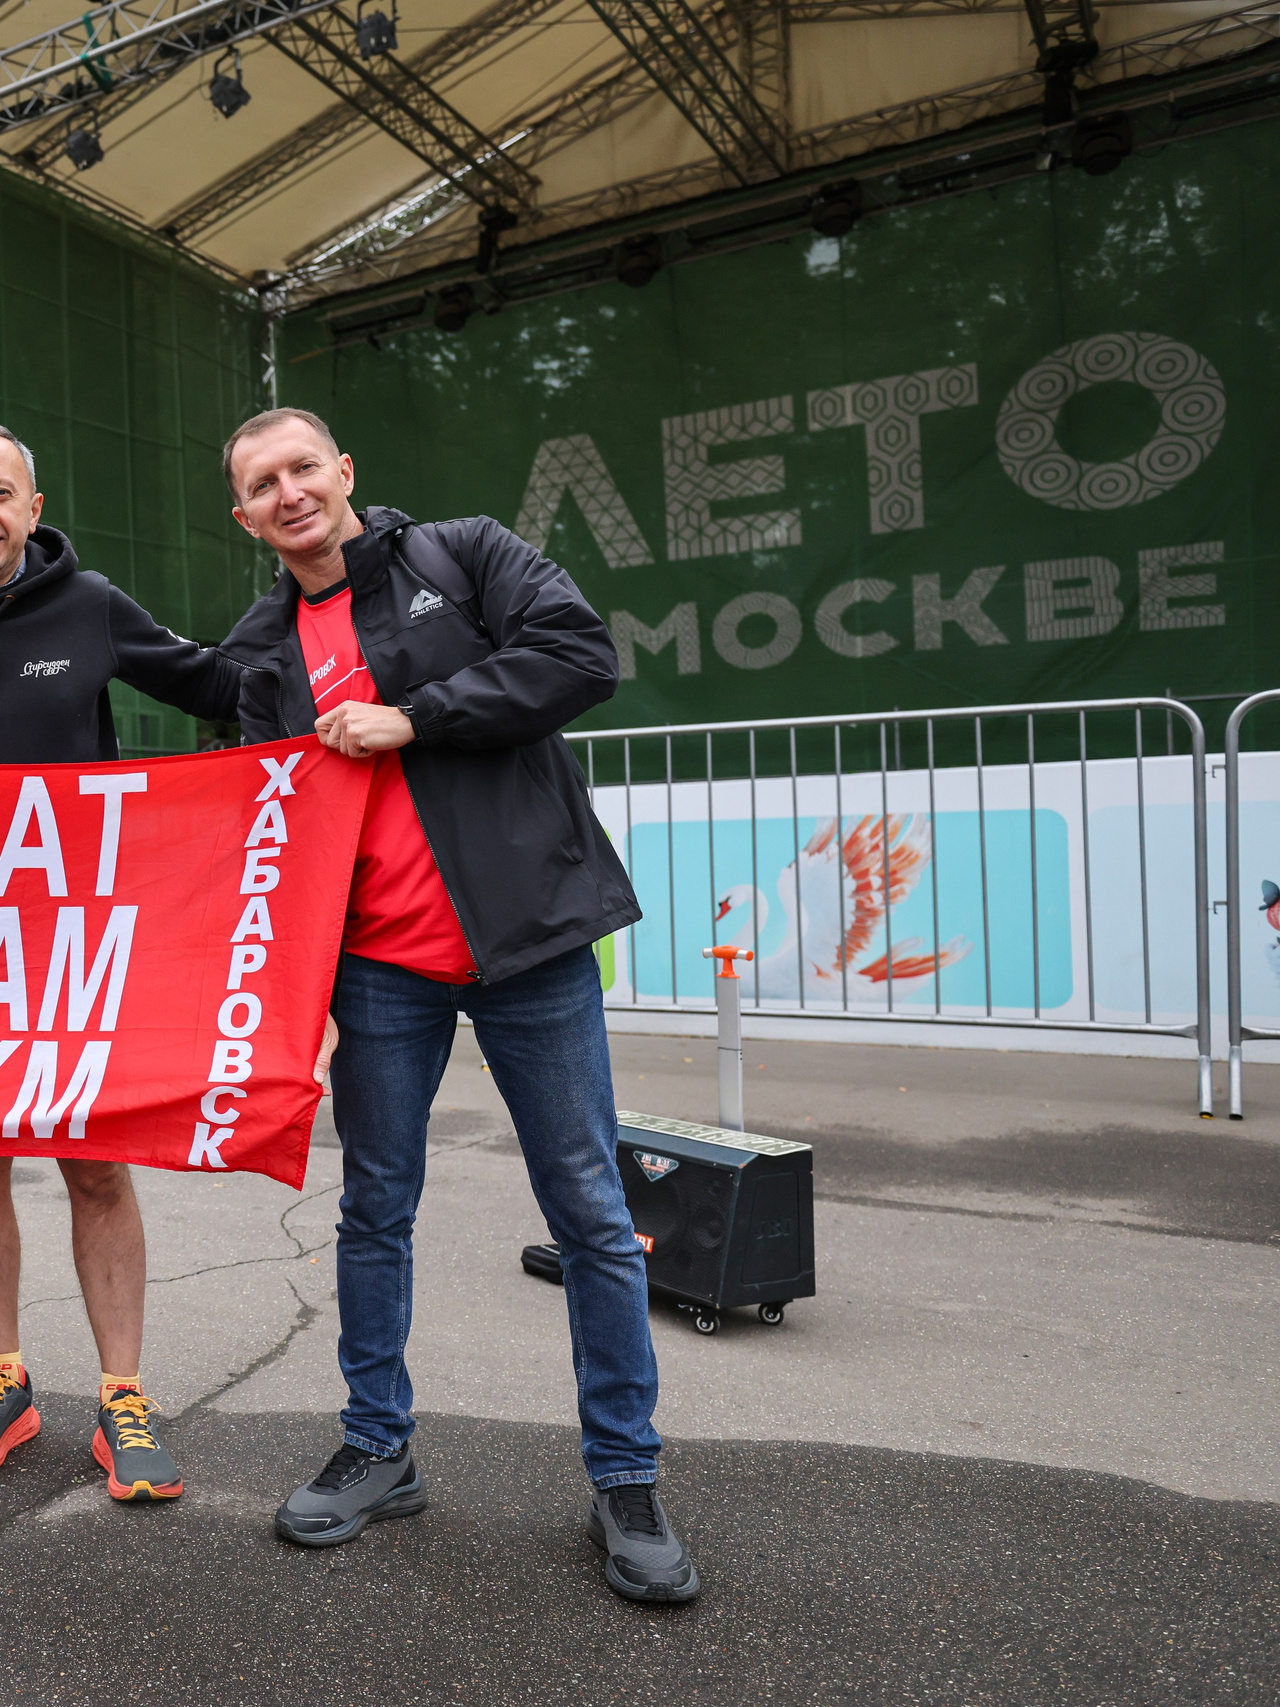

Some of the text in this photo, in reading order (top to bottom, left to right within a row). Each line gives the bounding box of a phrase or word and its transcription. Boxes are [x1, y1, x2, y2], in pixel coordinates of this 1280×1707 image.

[513, 331, 1226, 571] ЛЕТО
[310, 654, 336, 687] АРОВСК
[410, 602, 443, 619] ATHLETICS
[610, 541, 1226, 680] МОСКВЕ
[187, 751, 305, 1168] ХАБАРОВСК
